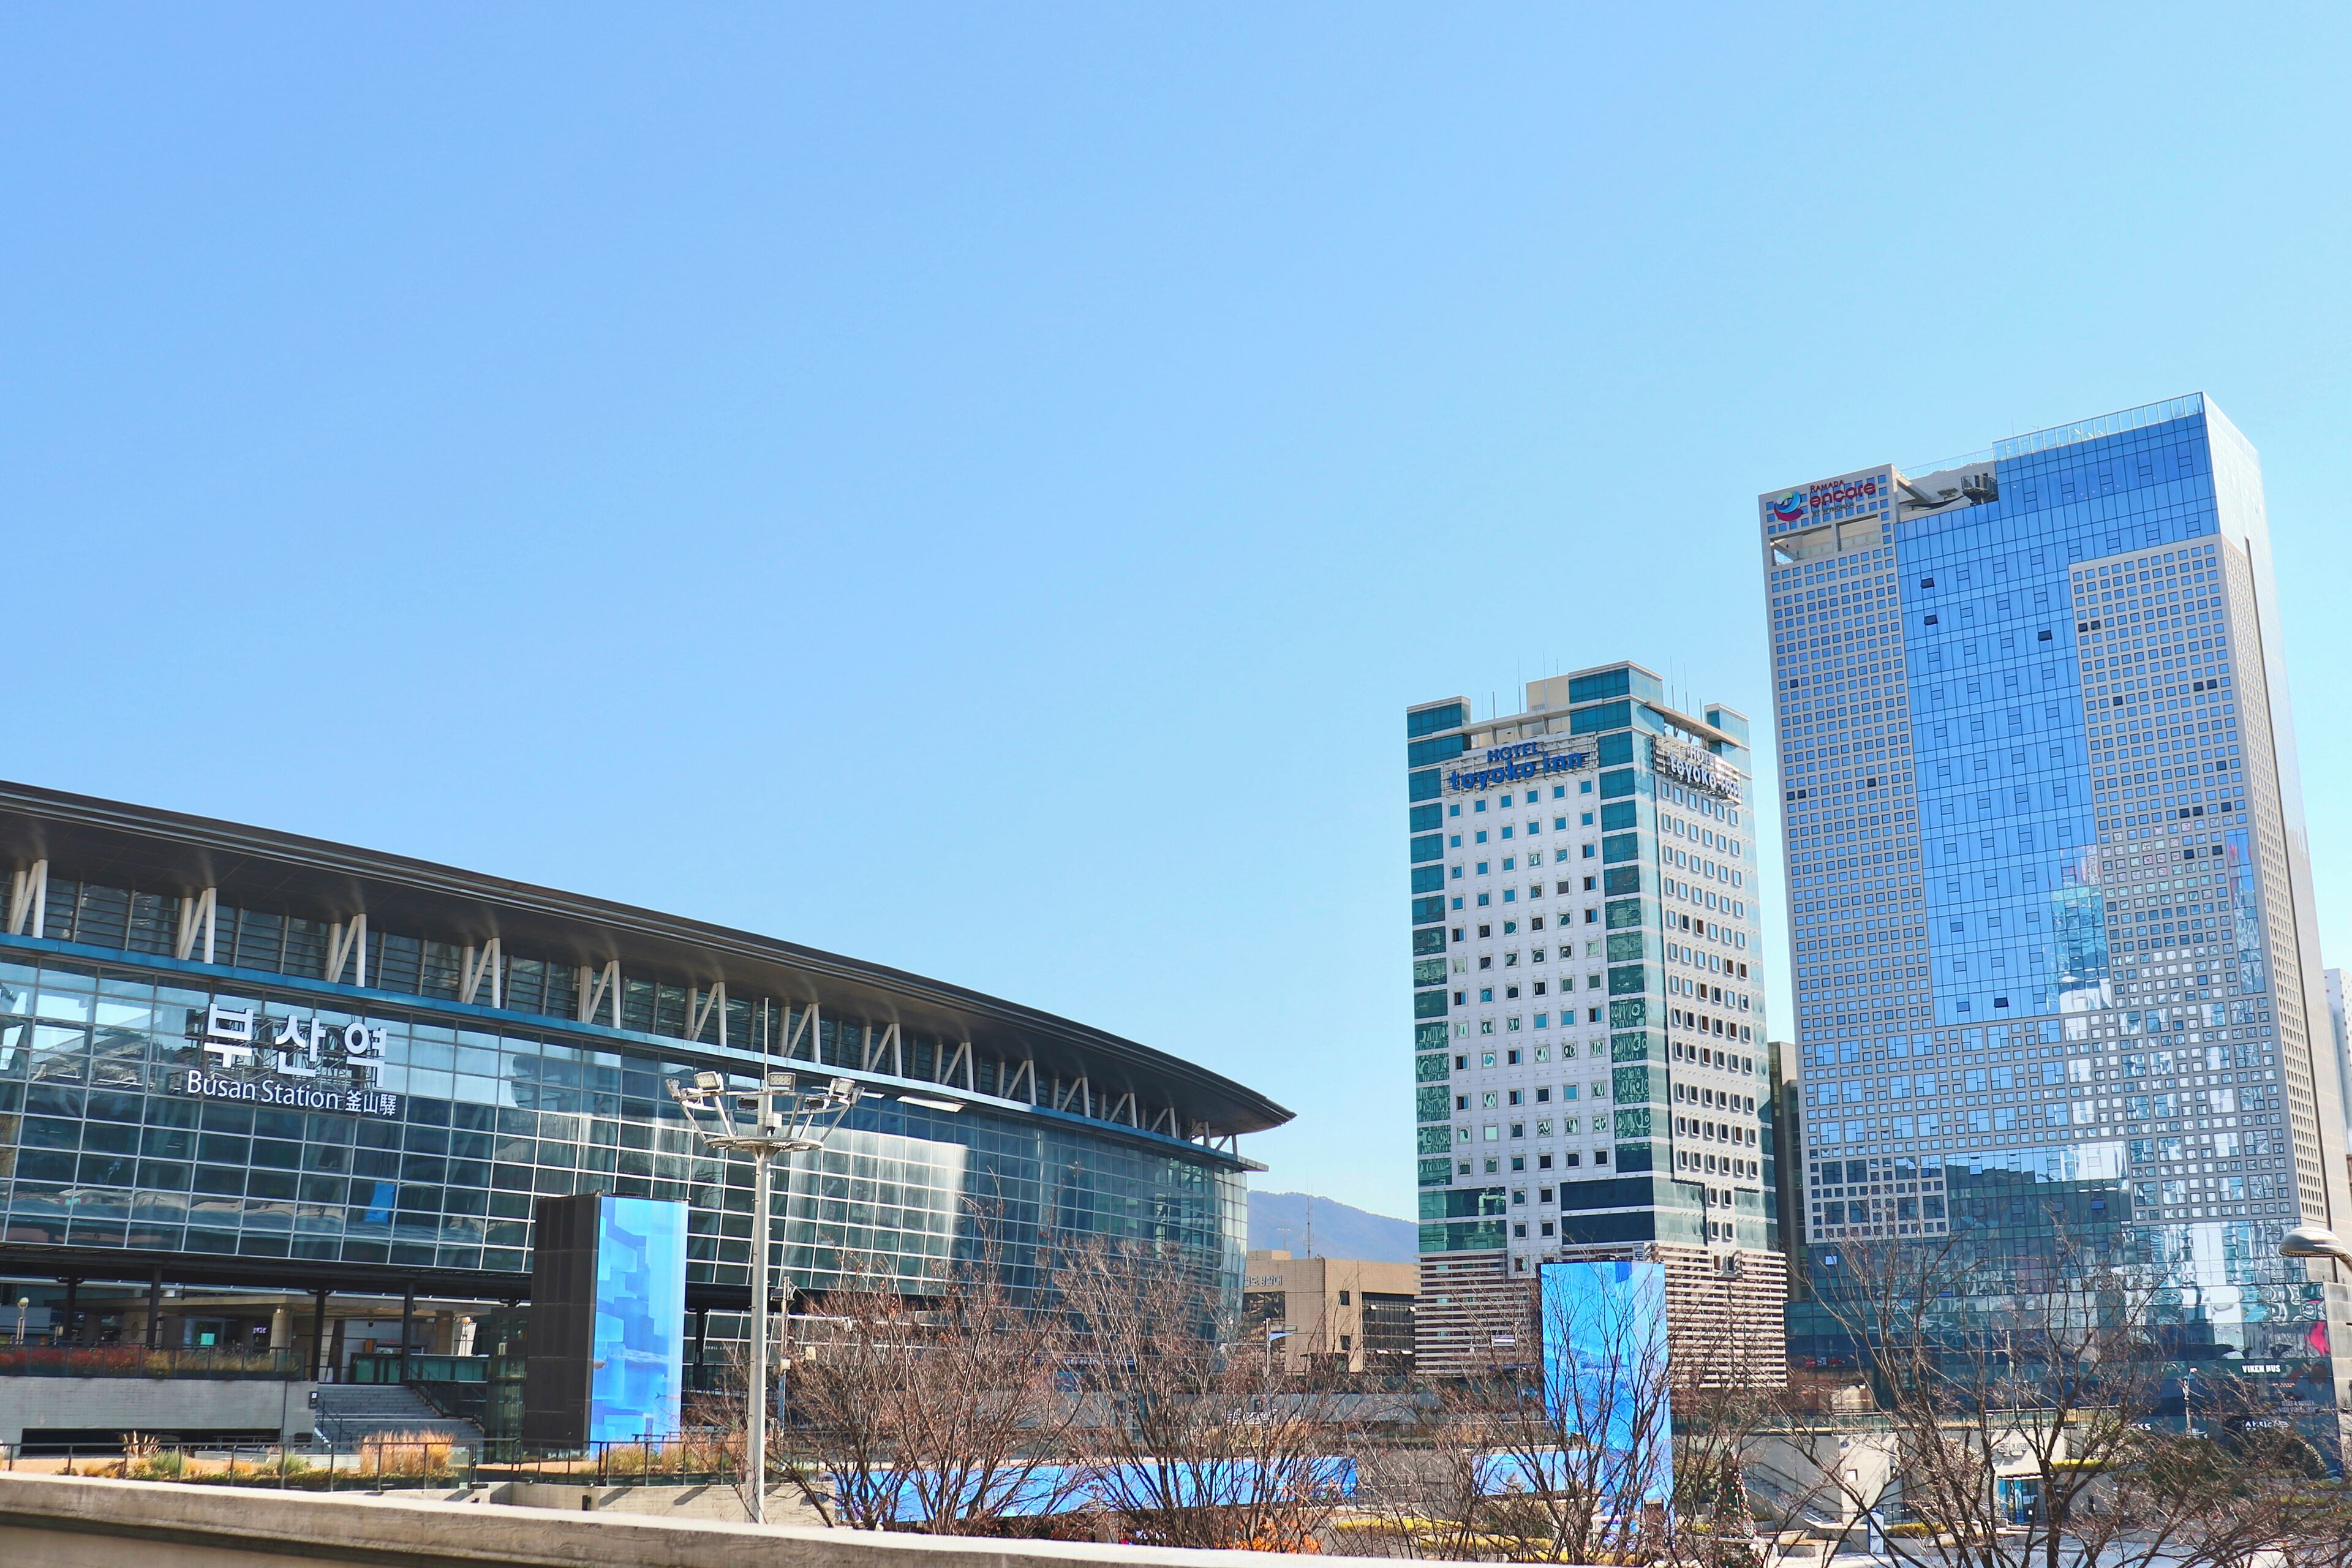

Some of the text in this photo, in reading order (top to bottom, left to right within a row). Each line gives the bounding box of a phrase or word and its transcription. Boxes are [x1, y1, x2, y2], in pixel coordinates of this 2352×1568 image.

[1809, 482, 1876, 508] encore
[1810, 480, 1845, 492] RAMADA
[1487, 741, 1540, 763] HOTEL
[1449, 751, 1583, 791] toyoko inn
[1670, 752, 1716, 788] toyoko
[203, 1003, 388, 1088] 부산역
[187, 1069, 338, 1110] Busan Station
[345, 1089, 397, 1117] 釜山驛
[2266, 1364, 2281, 1373] HUS
